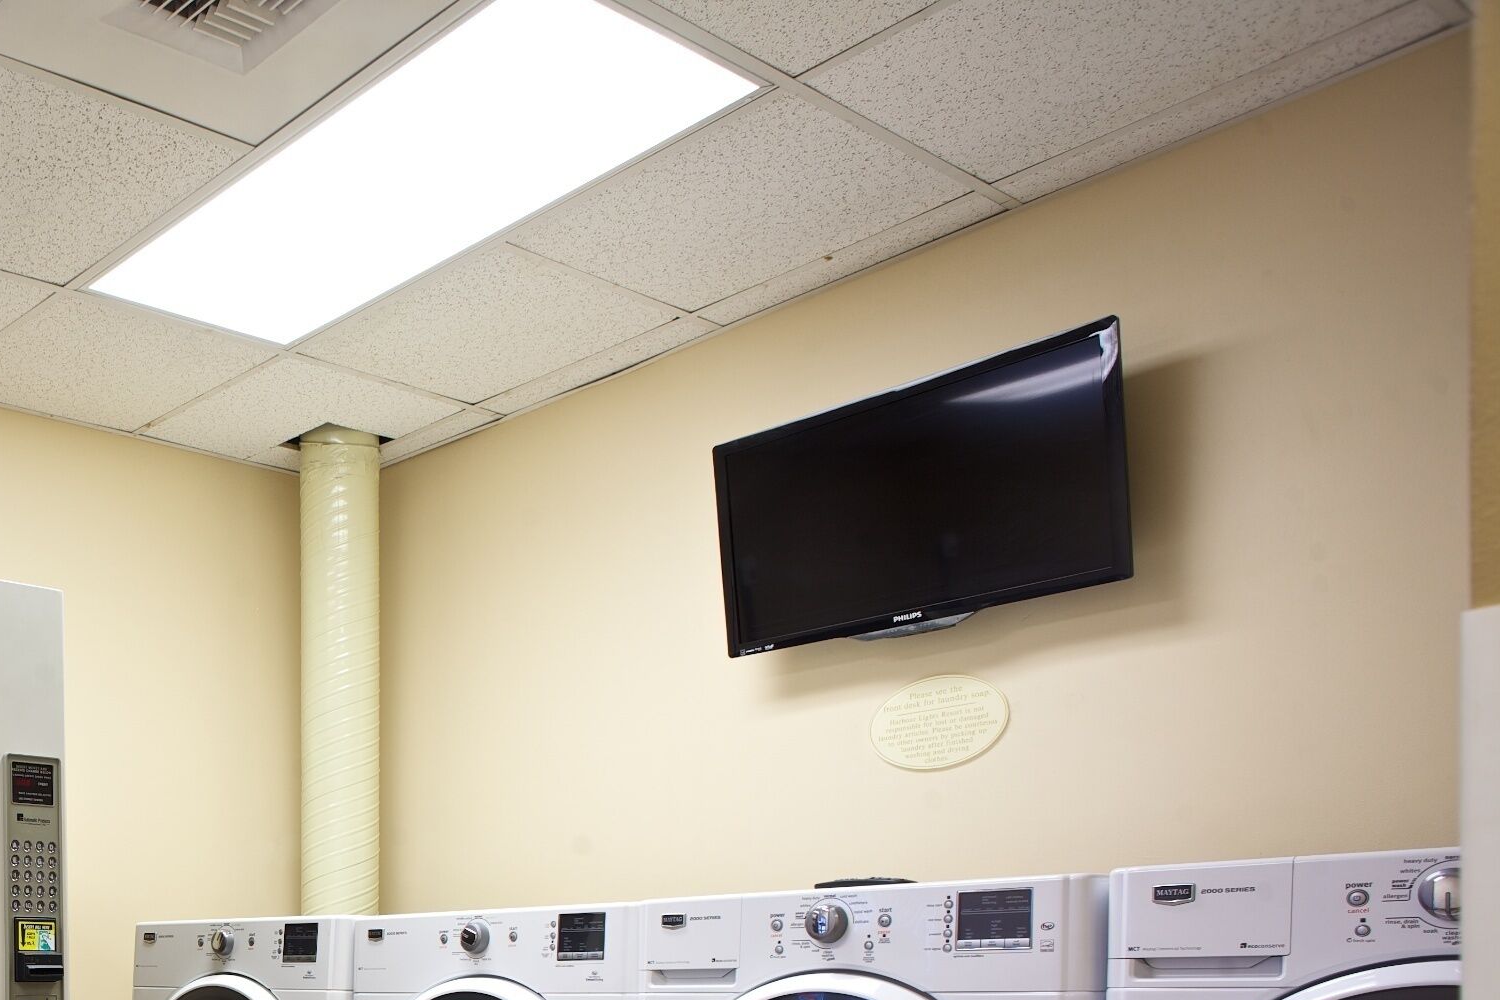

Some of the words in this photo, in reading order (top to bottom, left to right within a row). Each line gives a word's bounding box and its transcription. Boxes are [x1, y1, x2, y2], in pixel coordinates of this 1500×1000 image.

[893, 611, 922, 623] PHILIPS
[939, 693, 968, 704] laundry
[1345, 881, 1373, 890] power
[1156, 888, 1190, 897] MAYTAG
